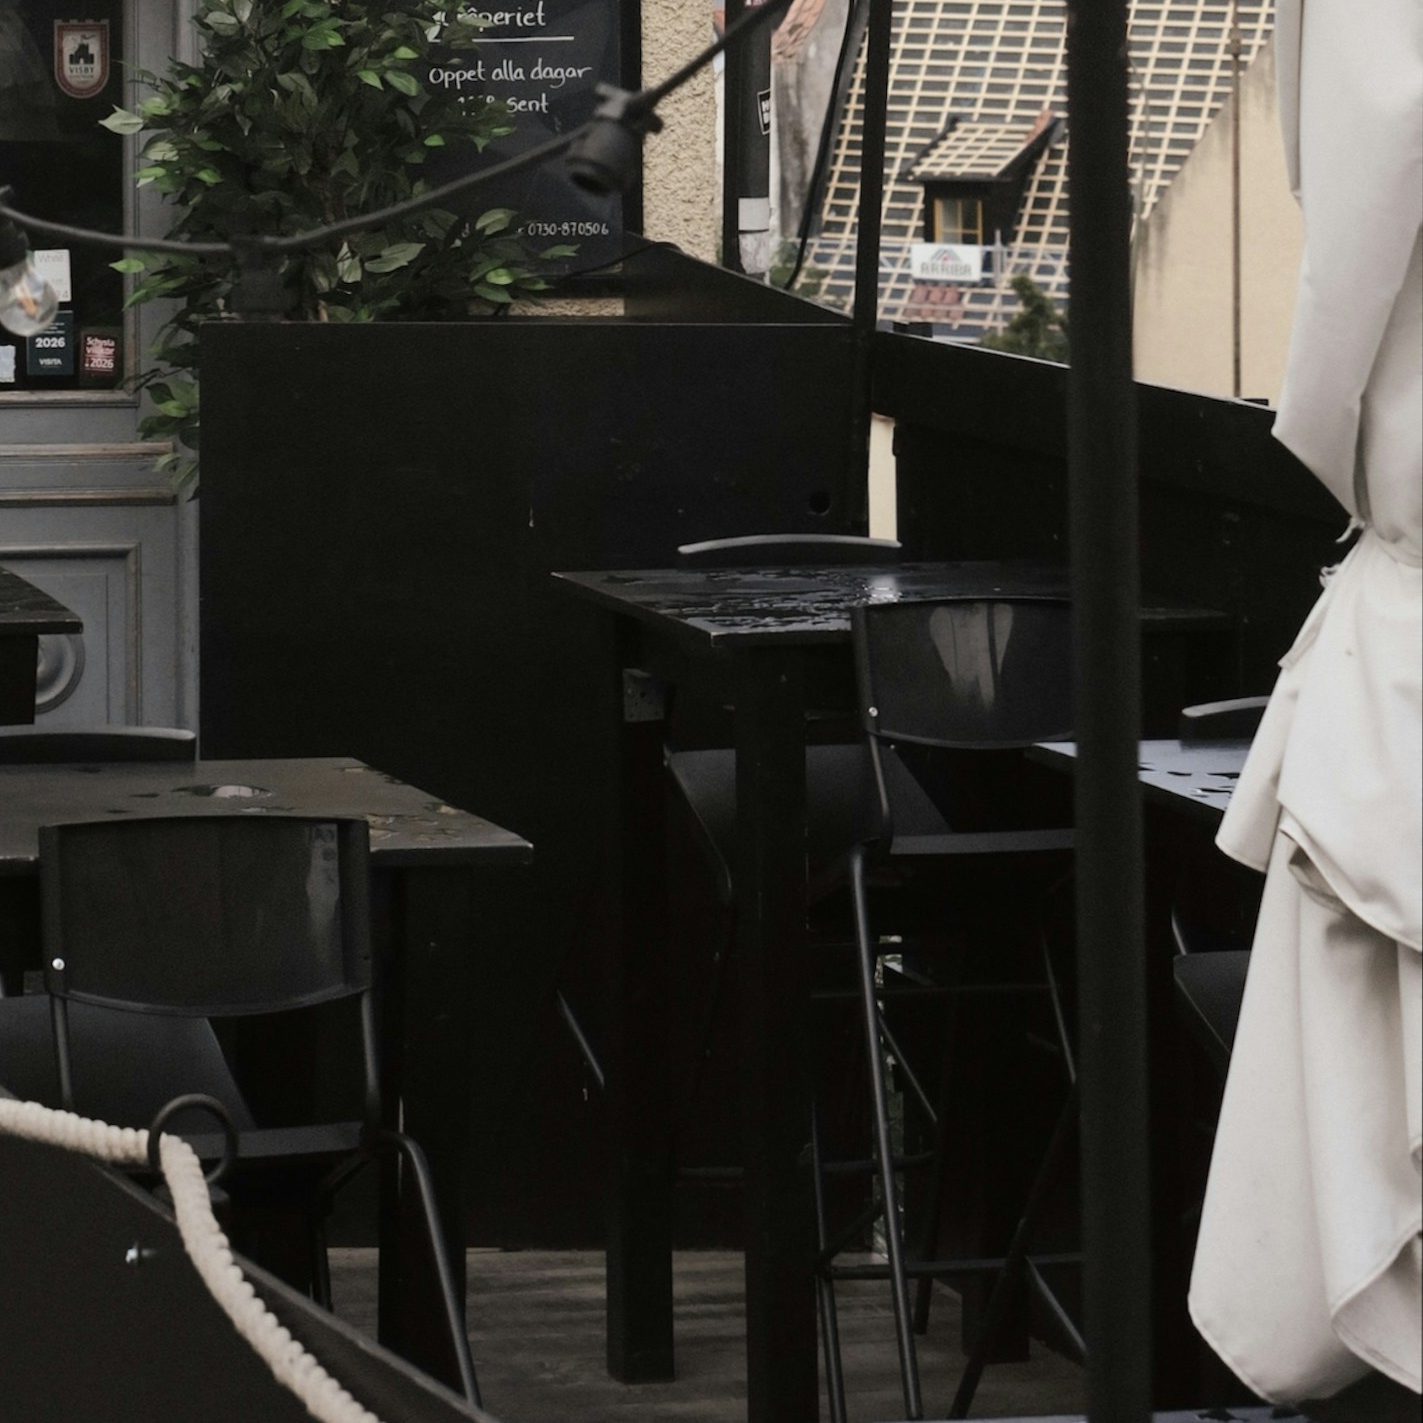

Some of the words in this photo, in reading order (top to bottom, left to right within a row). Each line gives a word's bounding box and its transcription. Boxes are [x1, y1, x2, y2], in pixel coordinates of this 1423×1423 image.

[69, 66, 95, 74] VISBY
[491, 59, 526, 82] alla
[530, 57, 593, 89] dagar
[506, 93, 549, 114] sent
[528, 221, 610, 237] 0730-870506
[35, 337, 66, 349] 2026
[90, 358, 115, 369] 2026
